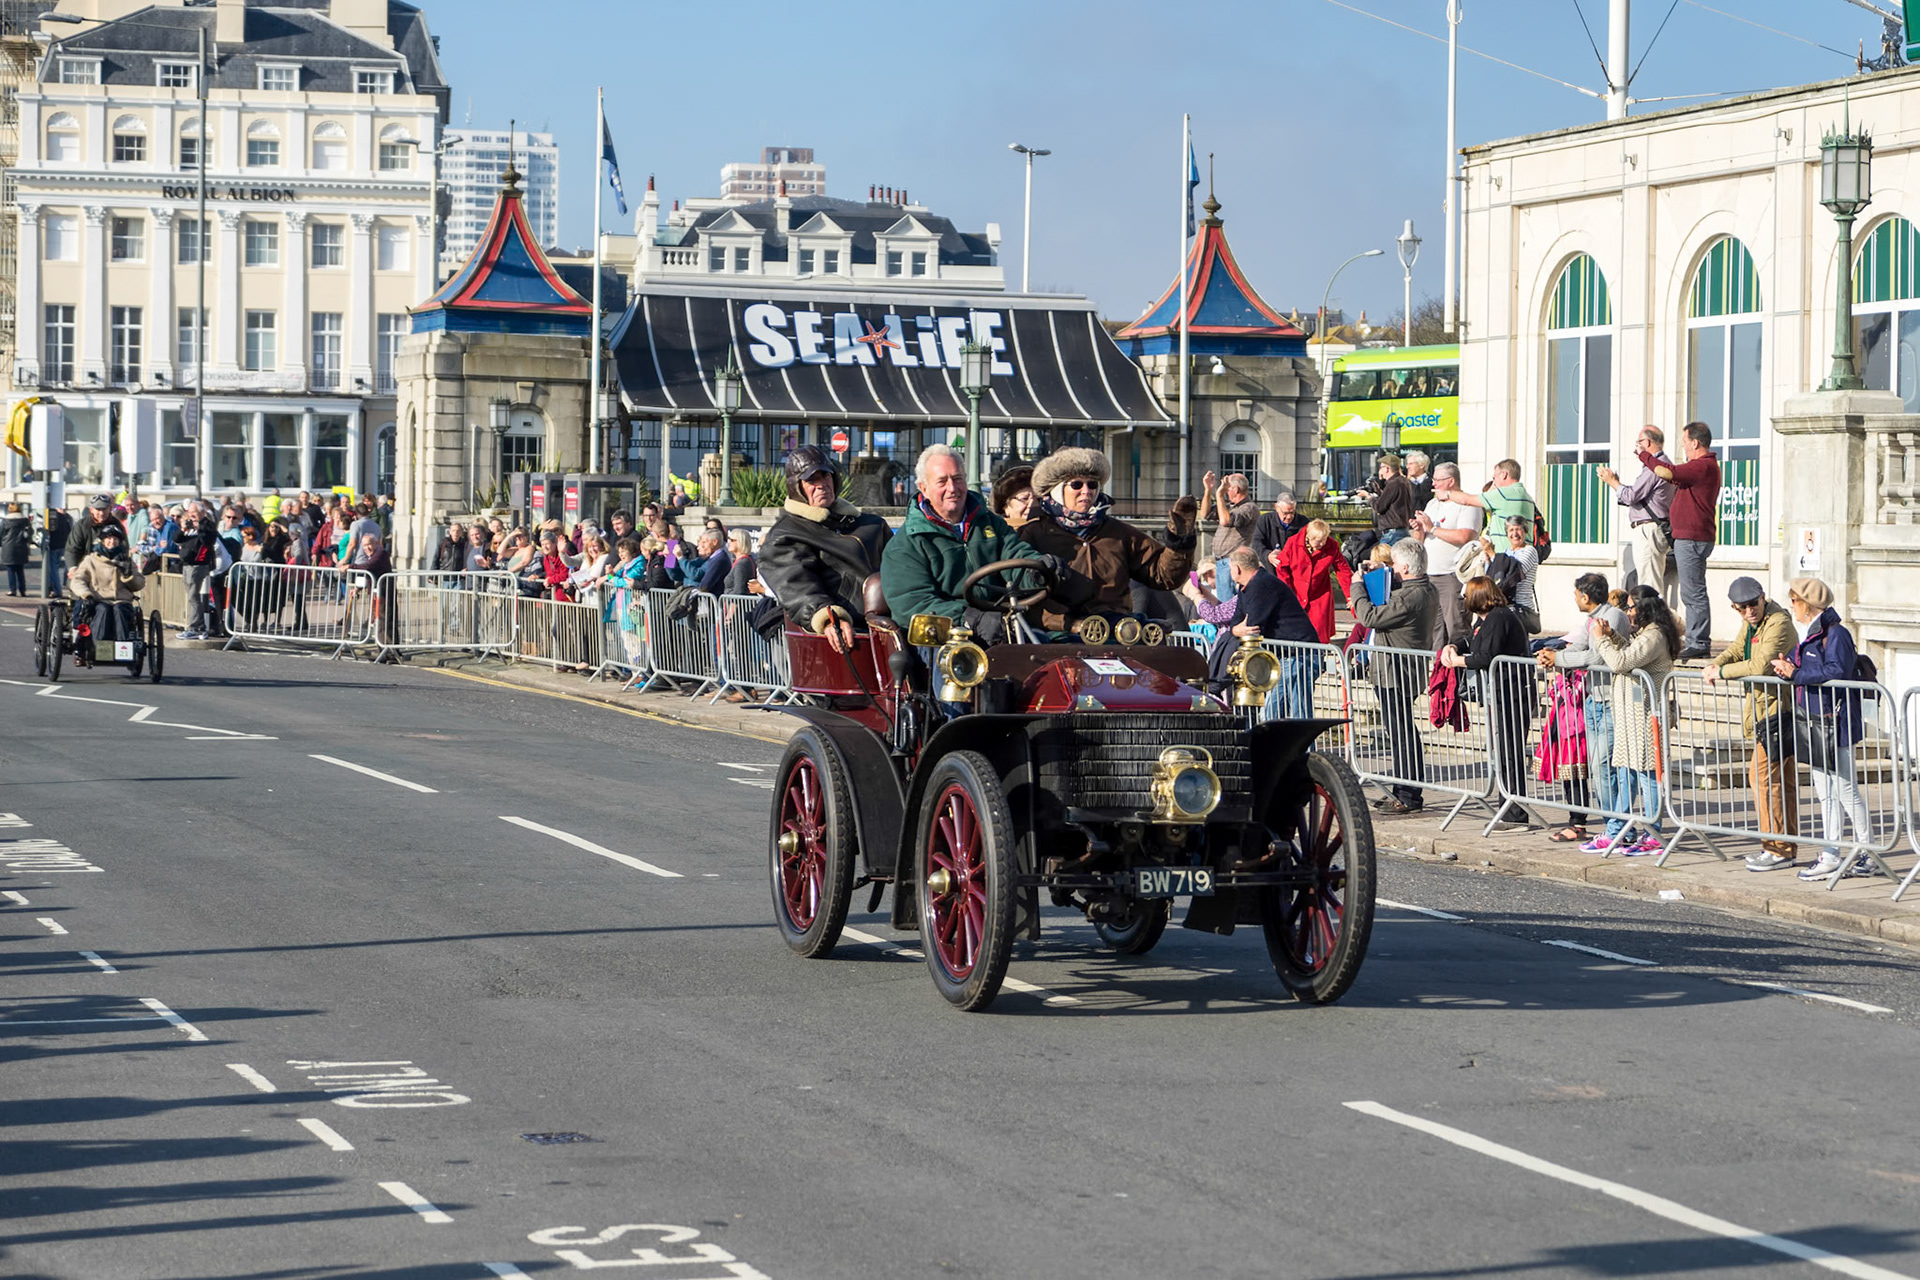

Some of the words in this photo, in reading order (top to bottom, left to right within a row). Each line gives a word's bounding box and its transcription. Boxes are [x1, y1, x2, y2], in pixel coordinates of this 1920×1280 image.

[226, 188, 295, 201] ALBION
[744, 303, 876, 368] SEA
[1387, 412, 1441, 427] Coaster
[1140, 870, 1210, 893] BW719
[286, 1060, 472, 1108] ONLY
